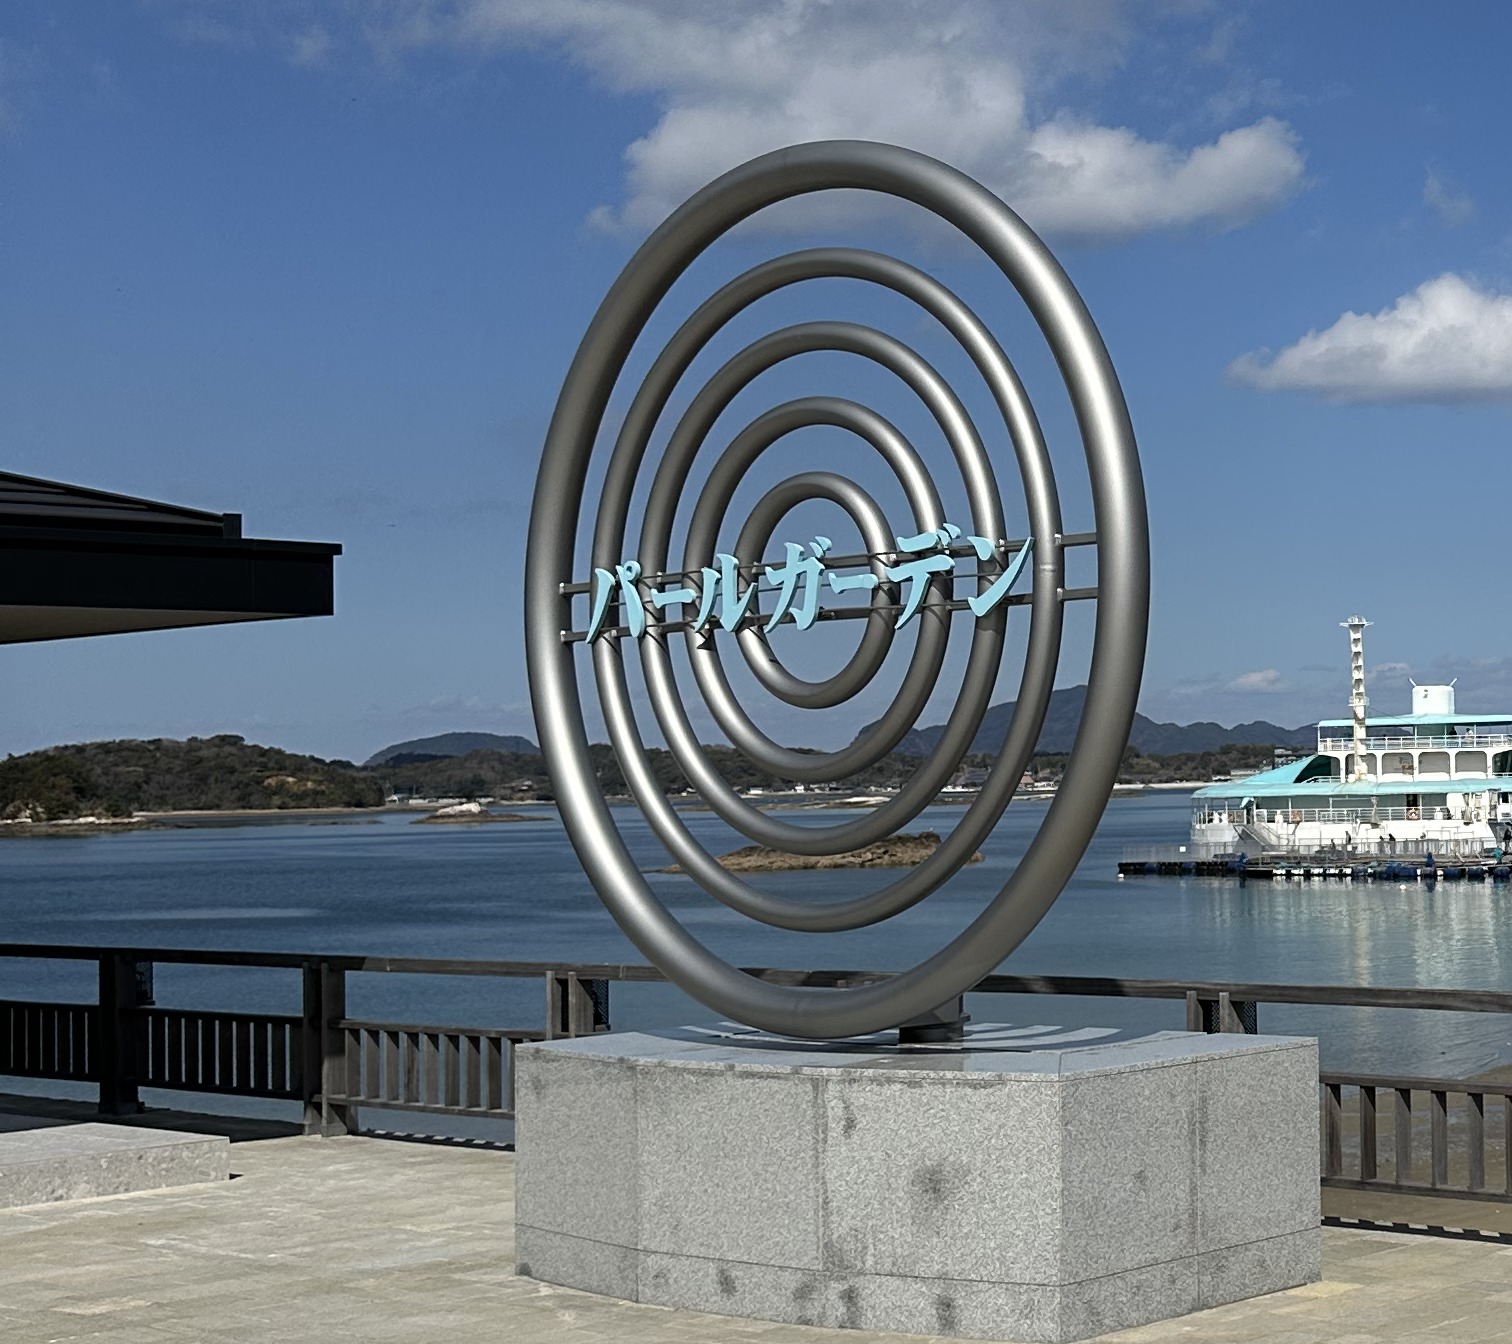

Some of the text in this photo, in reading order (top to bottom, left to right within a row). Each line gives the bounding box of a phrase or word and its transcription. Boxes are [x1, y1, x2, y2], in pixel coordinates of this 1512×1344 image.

[586, 522, 1035, 645] パールガーデン
